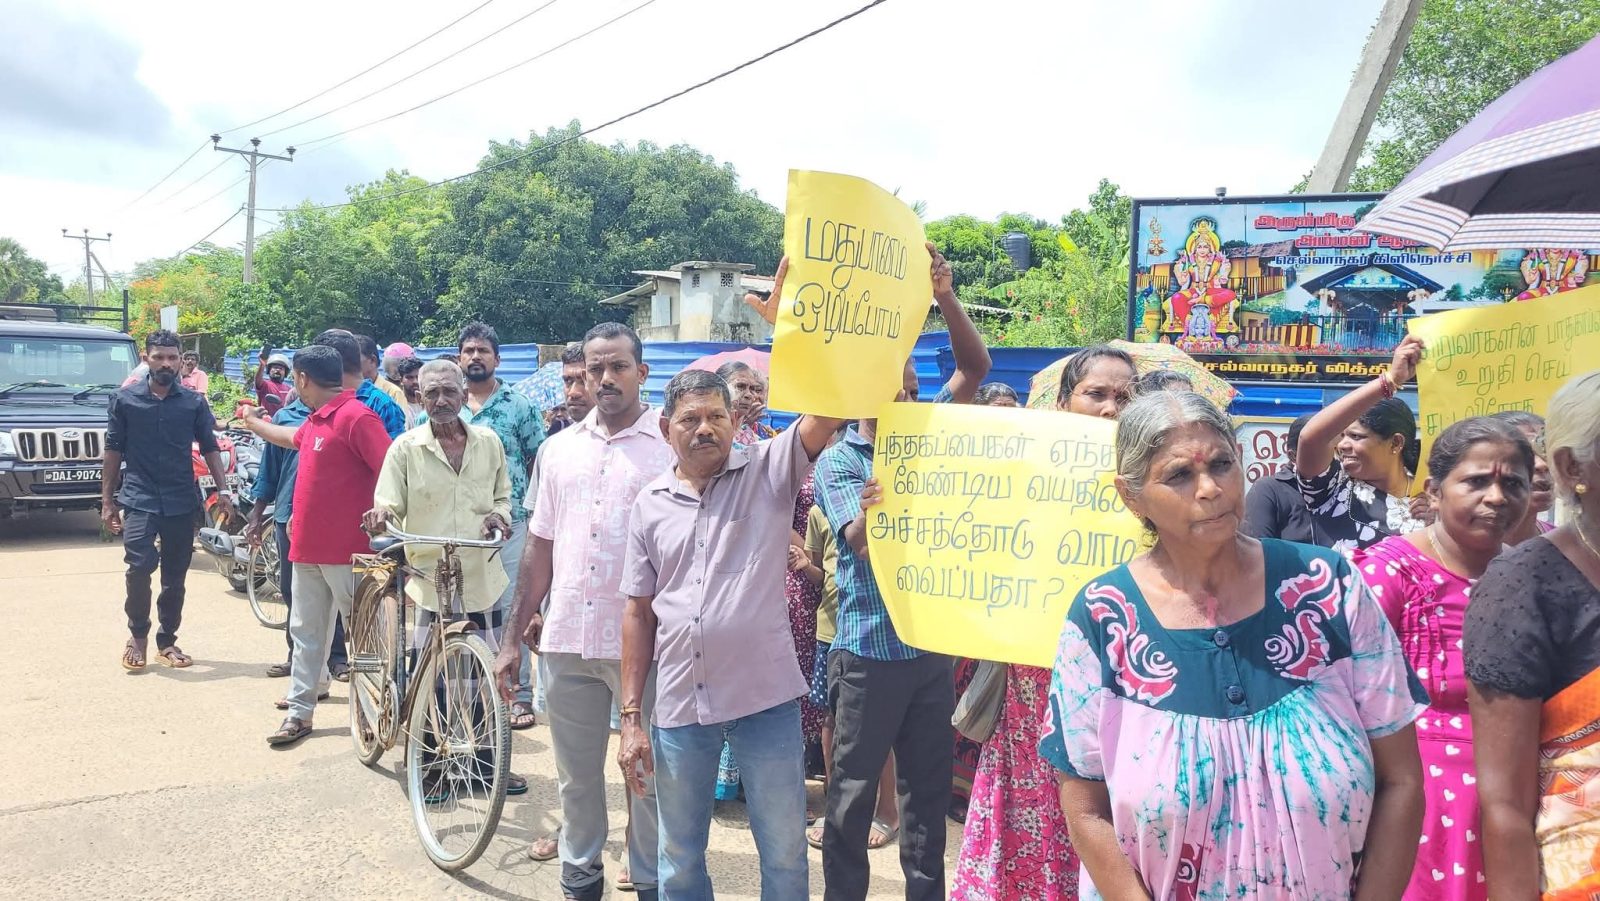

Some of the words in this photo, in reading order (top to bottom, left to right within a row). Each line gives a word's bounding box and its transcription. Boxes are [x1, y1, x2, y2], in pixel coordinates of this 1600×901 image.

[805, 217, 907, 290] மதுபானம்
[1275, 252, 1369, 266] செல்வாநகர்
[1374, 252, 1471, 266] கிளிநொச்சி
[1295, 232, 1371, 248] அம்மன்
[793, 283, 901, 344] ஒழிப்போம்
[1202, 361, 1318, 375] சல்வாநகர்
[1456, 354, 1516, 395] உறுதி
[877, 430, 1035, 466] புத்தகப்பைகள்
[52, 470, 102, 481] DAI-9074
[894, 464, 1011, 508] வேண்டிய
[870, 508, 1034, 562] அச்சத்தோடு
